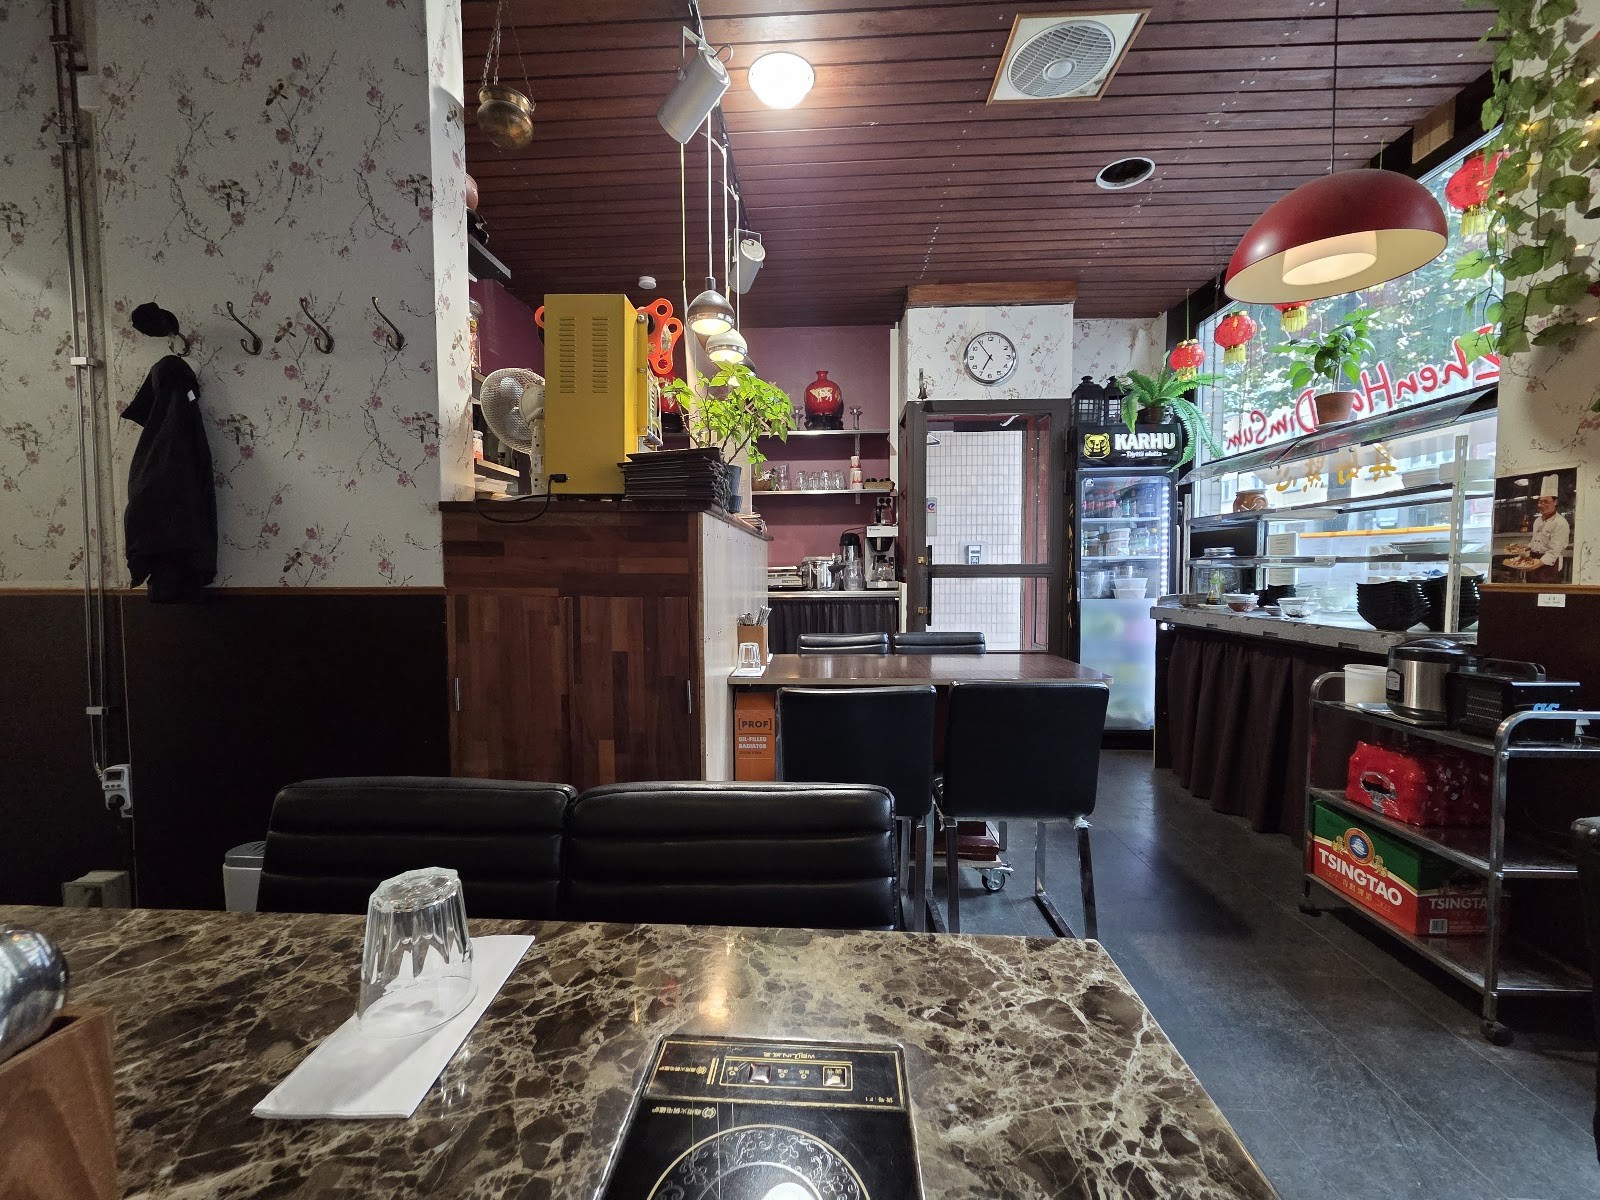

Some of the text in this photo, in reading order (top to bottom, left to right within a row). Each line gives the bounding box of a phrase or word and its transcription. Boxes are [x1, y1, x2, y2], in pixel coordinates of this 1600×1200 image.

[1114, 433, 1176, 451] KARHU
[1318, 847, 1403, 906] TSINGTAO
[1428, 897, 1489, 910] TSINGTA
